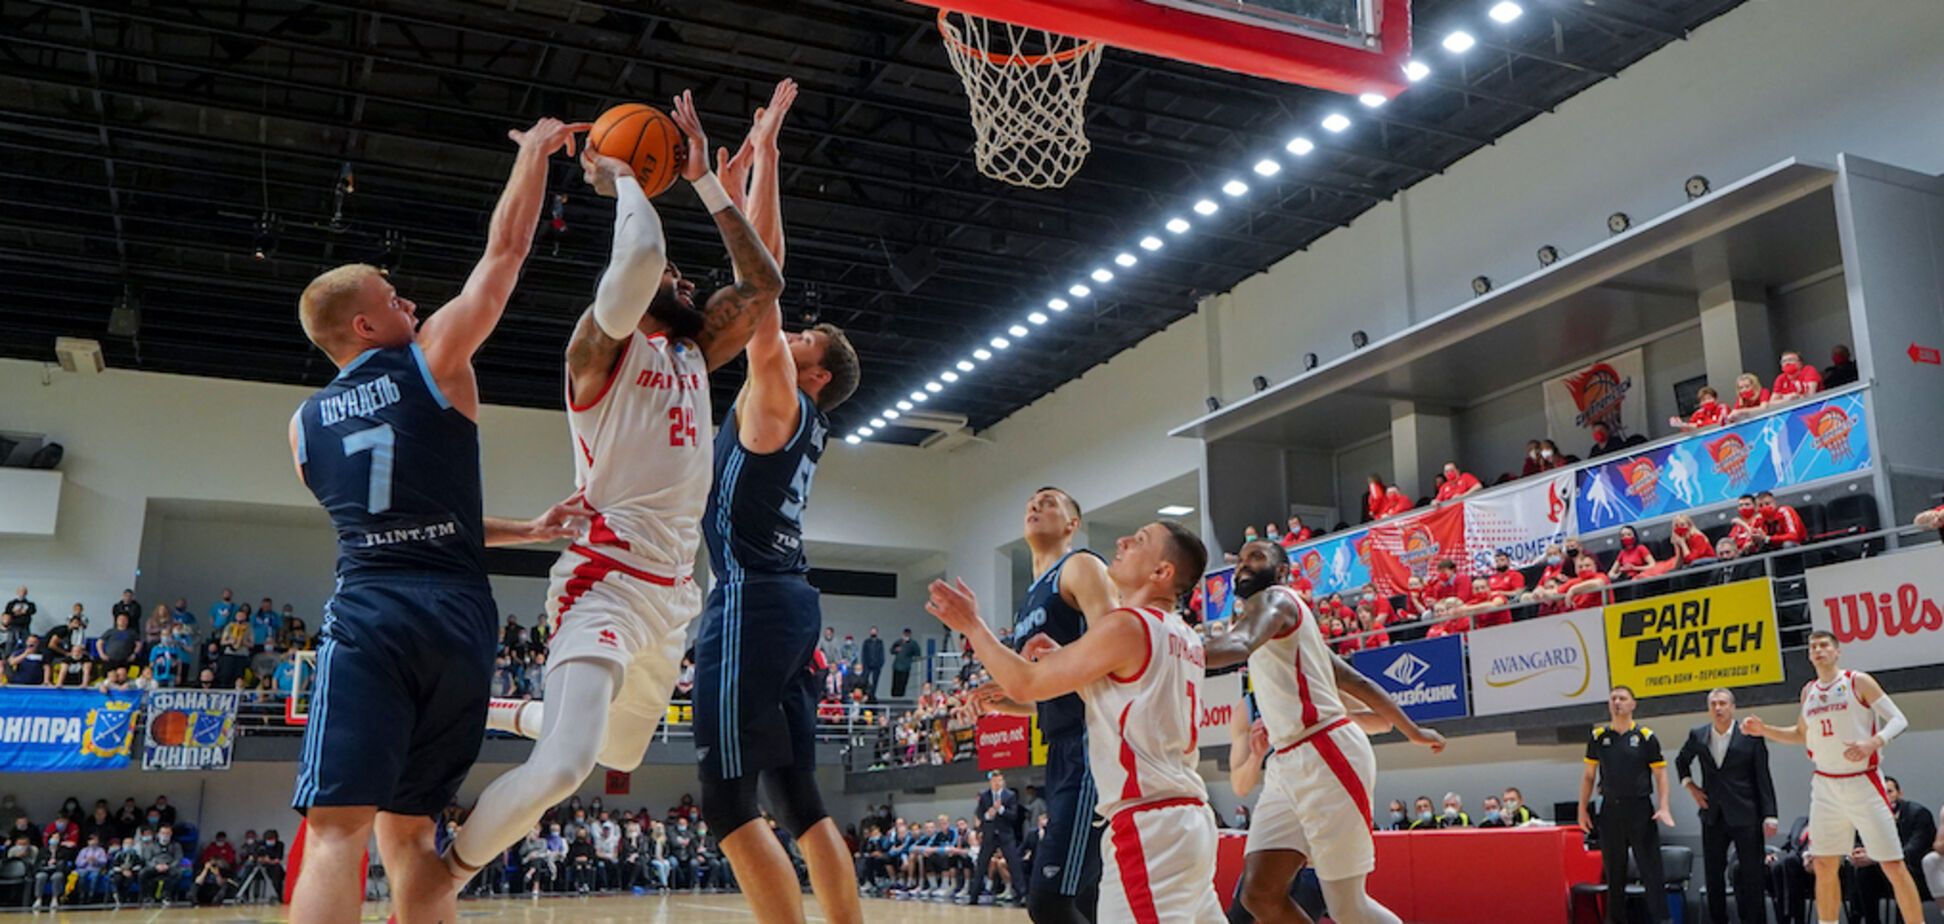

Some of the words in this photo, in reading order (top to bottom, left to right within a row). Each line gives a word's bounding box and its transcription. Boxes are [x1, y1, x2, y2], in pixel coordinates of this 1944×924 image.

[320, 375, 400, 426] ШУНДЕЛЬ
[668, 407, 697, 447] 24
[342, 423, 395, 514] 7
[1638, 598, 1711, 635] PARI
[1824, 583, 1944, 643] Wils
[1654, 620, 1764, 664] MATCH
[1491, 646, 1577, 676] AVANGARD
[153, 693, 232, 711] ФАНАТИ
[1200, 705, 1232, 728] son
[0, 716, 81, 744] НІПРА
[1821, 719, 1834, 736] 11
[152, 746, 225, 768] ДНІПРА
